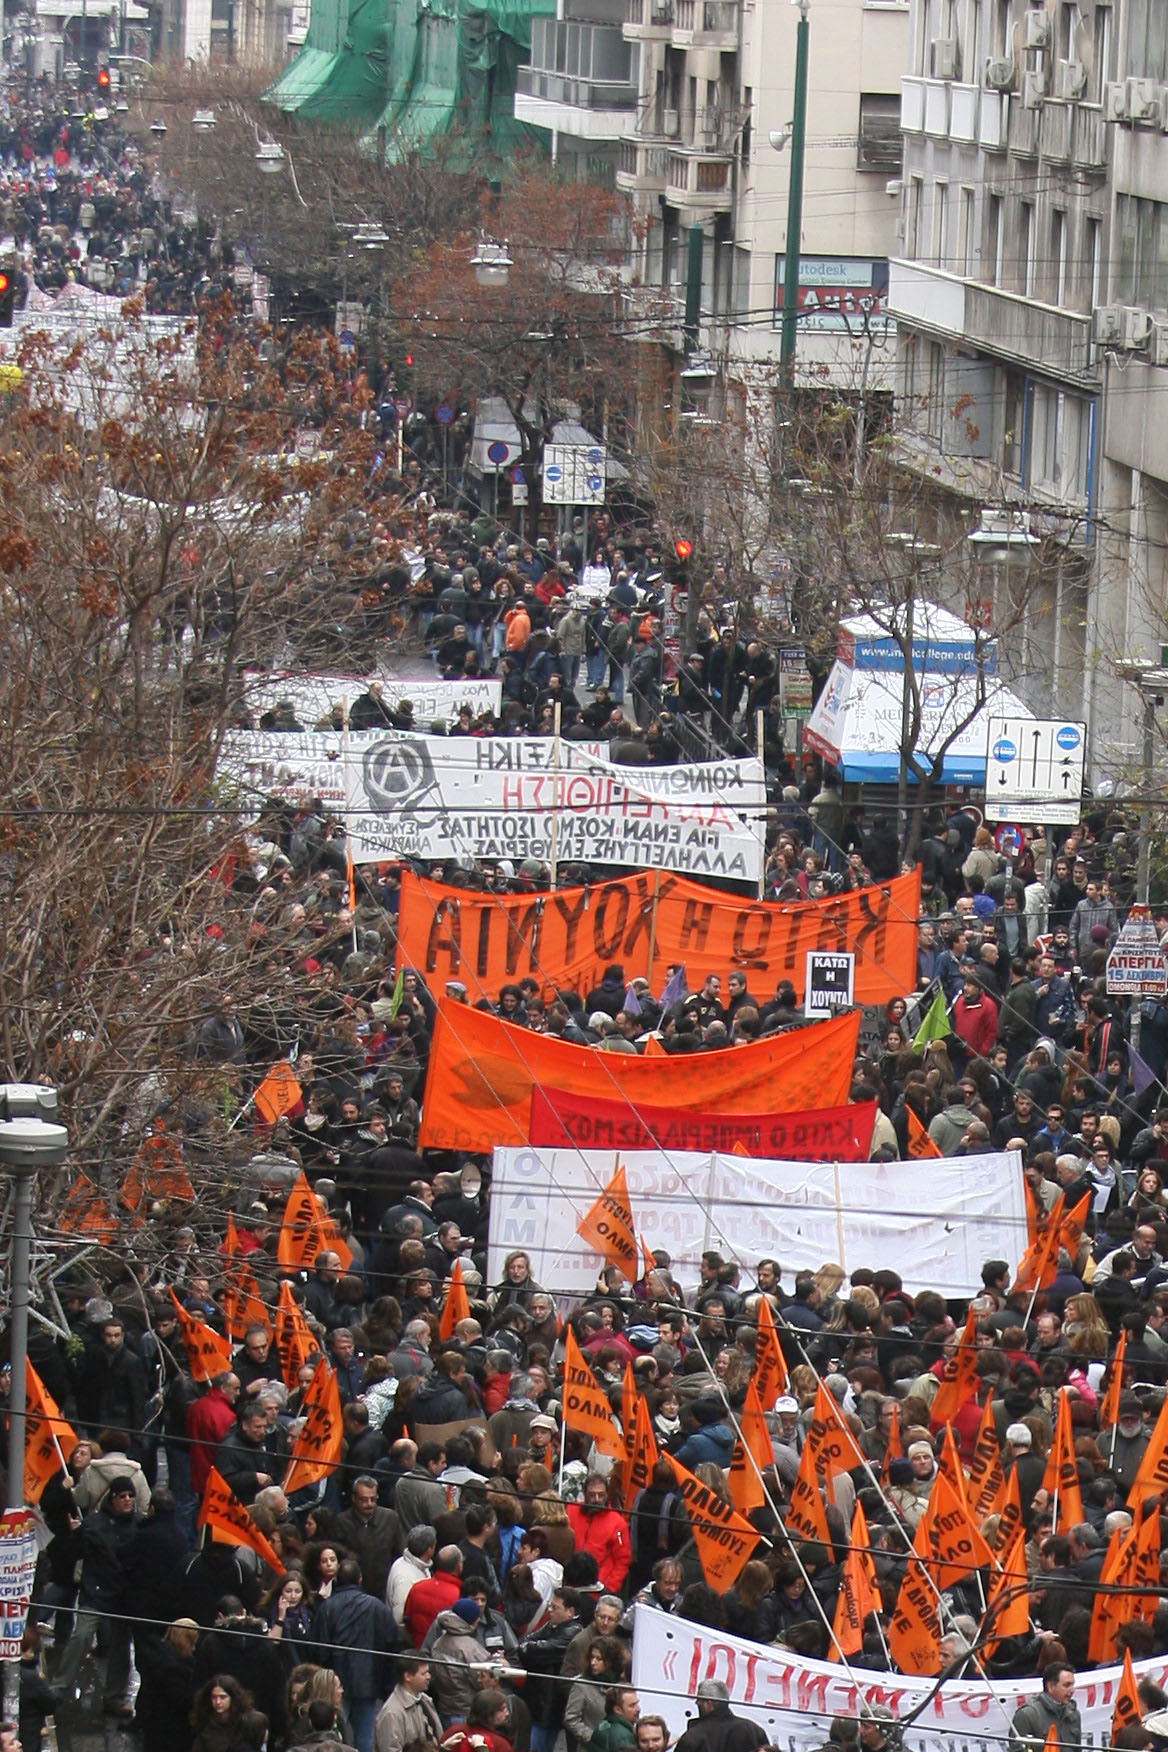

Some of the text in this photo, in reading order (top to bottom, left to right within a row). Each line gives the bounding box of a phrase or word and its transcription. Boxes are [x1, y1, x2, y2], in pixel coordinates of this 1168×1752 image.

[798, 263, 847, 276] utodesk
[814, 957, 848, 968] ΚΑΤΩ
[1108, 956, 1165, 969] ΑΠΕΡΓΙΑ
[825, 971, 836, 982] Η
[1108, 969, 1124, 980] 15
[811, 990, 849, 1007] ΧΟΥΝΤΑ
[680, 1478, 734, 1523] ΟΛΟΙ
